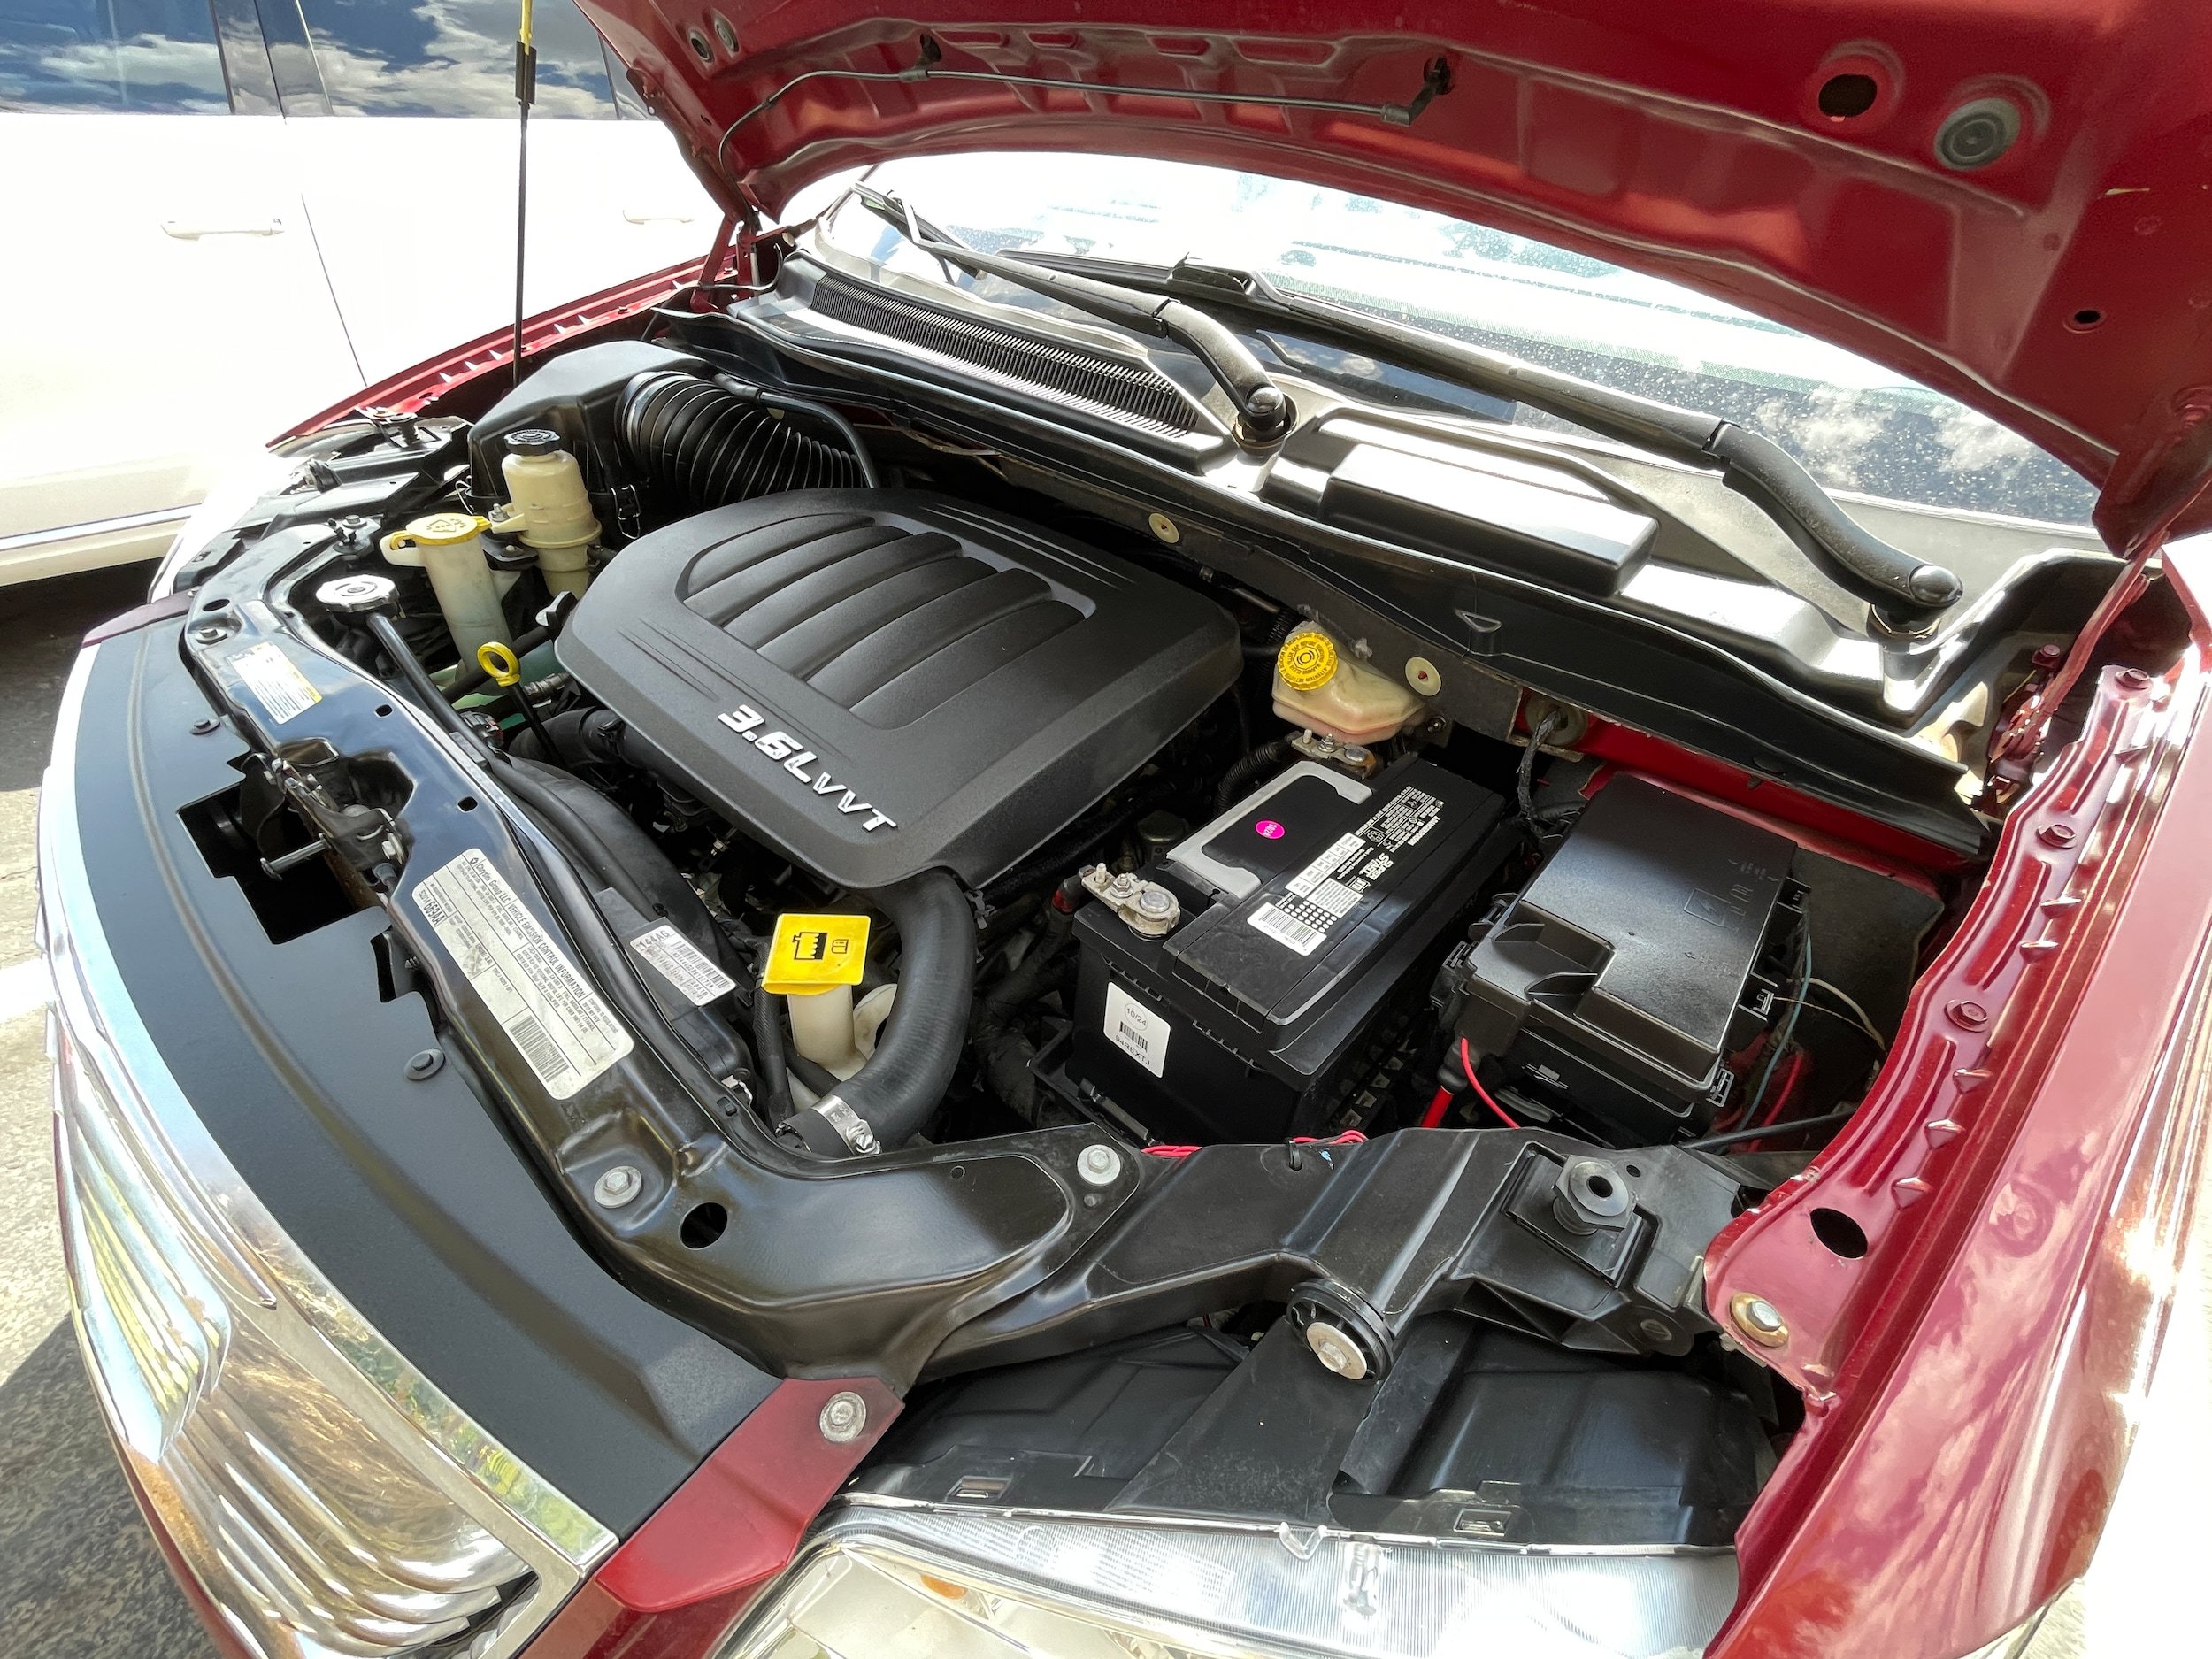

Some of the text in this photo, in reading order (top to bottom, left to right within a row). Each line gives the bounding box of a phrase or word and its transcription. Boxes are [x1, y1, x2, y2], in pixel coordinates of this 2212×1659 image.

[718, 704, 897, 832] 3.6L VVT
[473, 862, 511, 904] Chrysler Group LLC
[506, 902, 526, 924] VEHICLE
[520, 919, 543, 945] EMISSION
[537, 941, 560, 966] CONTROL
[554, 962, 586, 999] INFORMATION
[1125, 1006, 1147, 1027] 10/24
